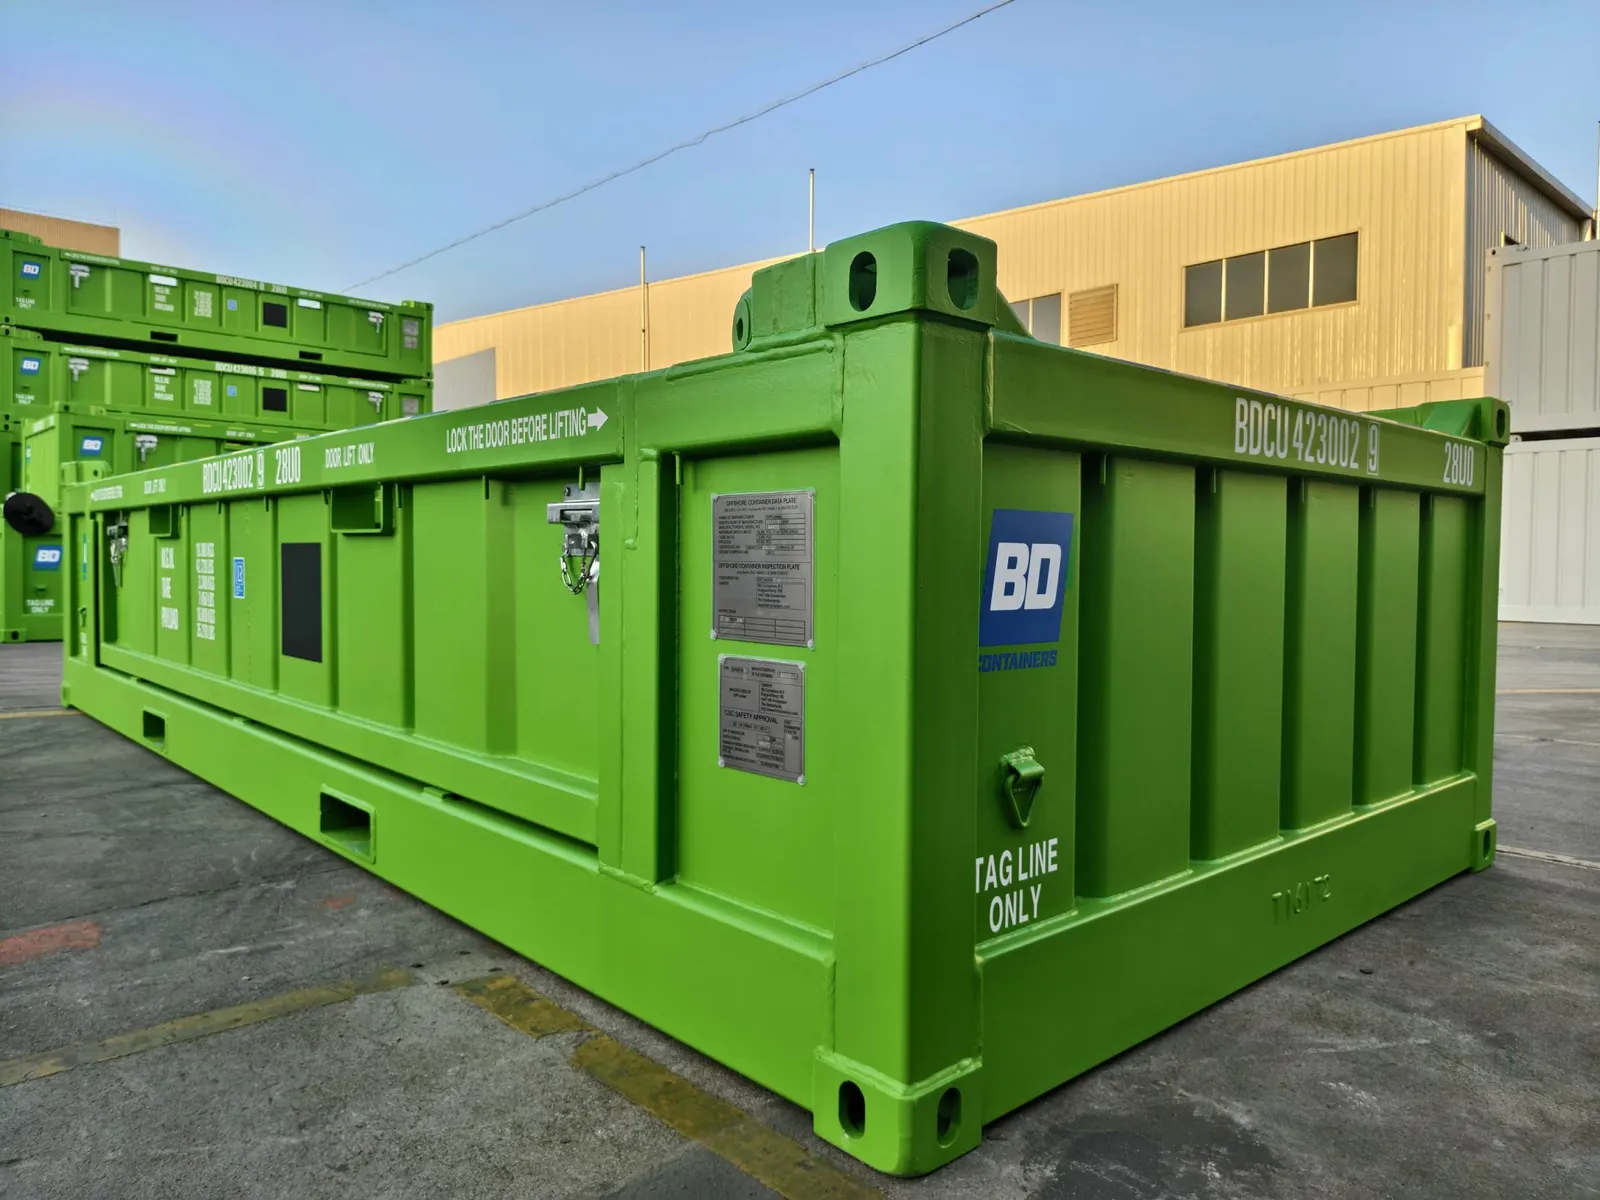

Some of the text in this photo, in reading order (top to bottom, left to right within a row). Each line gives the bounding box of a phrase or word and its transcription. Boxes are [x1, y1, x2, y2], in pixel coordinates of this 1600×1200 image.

[23, 263, 40, 274] BD
[23, 360, 40, 370] BD
[82, 439, 102, 450] BD
[446, 407, 586, 453] LOCK THE DOOR BEFORE LIFTING
[1234, 397, 1475, 486] BDCU 423002 9 28U0
[222, 454, 253, 491] 423002
[257, 452, 264, 488] 9
[275, 446, 301, 485] 28U0
[325, 442, 375, 469] DOOR LIFT ONLY
[36, 550, 61, 562] BD
[990, 542, 1062, 611] BD
[724, 709, 778, 724] CSC SAFETY APPROVAL
[975, 837, 1058, 894] TAG LINE
[989, 883, 1042, 933] ONLY
